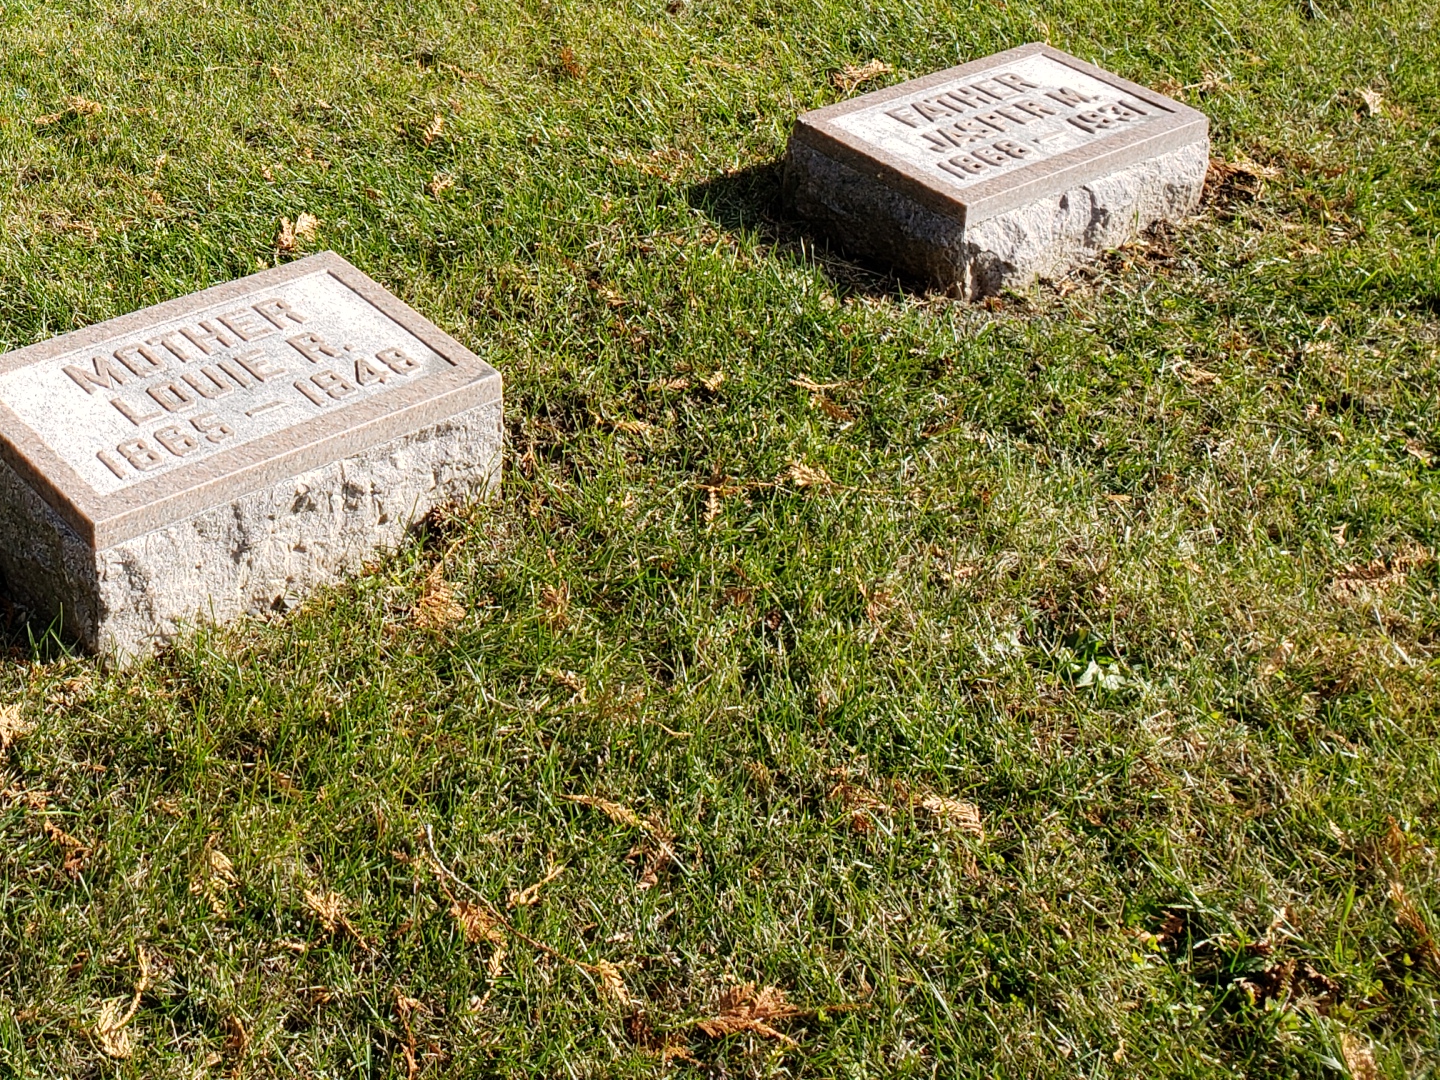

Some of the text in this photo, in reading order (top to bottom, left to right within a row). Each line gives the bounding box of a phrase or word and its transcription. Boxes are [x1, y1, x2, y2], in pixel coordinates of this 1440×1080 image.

[884, 72, 1039, 129] FATHER
[921, 99, 1058, 153] JASPER
[1067, 99, 1152, 134] 1931
[61, 297, 308, 395] MOTHER
[110, 331, 355, 427] LOUIE R.
[96, 413, 236, 480] 1865
[293, 346, 422, 408] 1948
